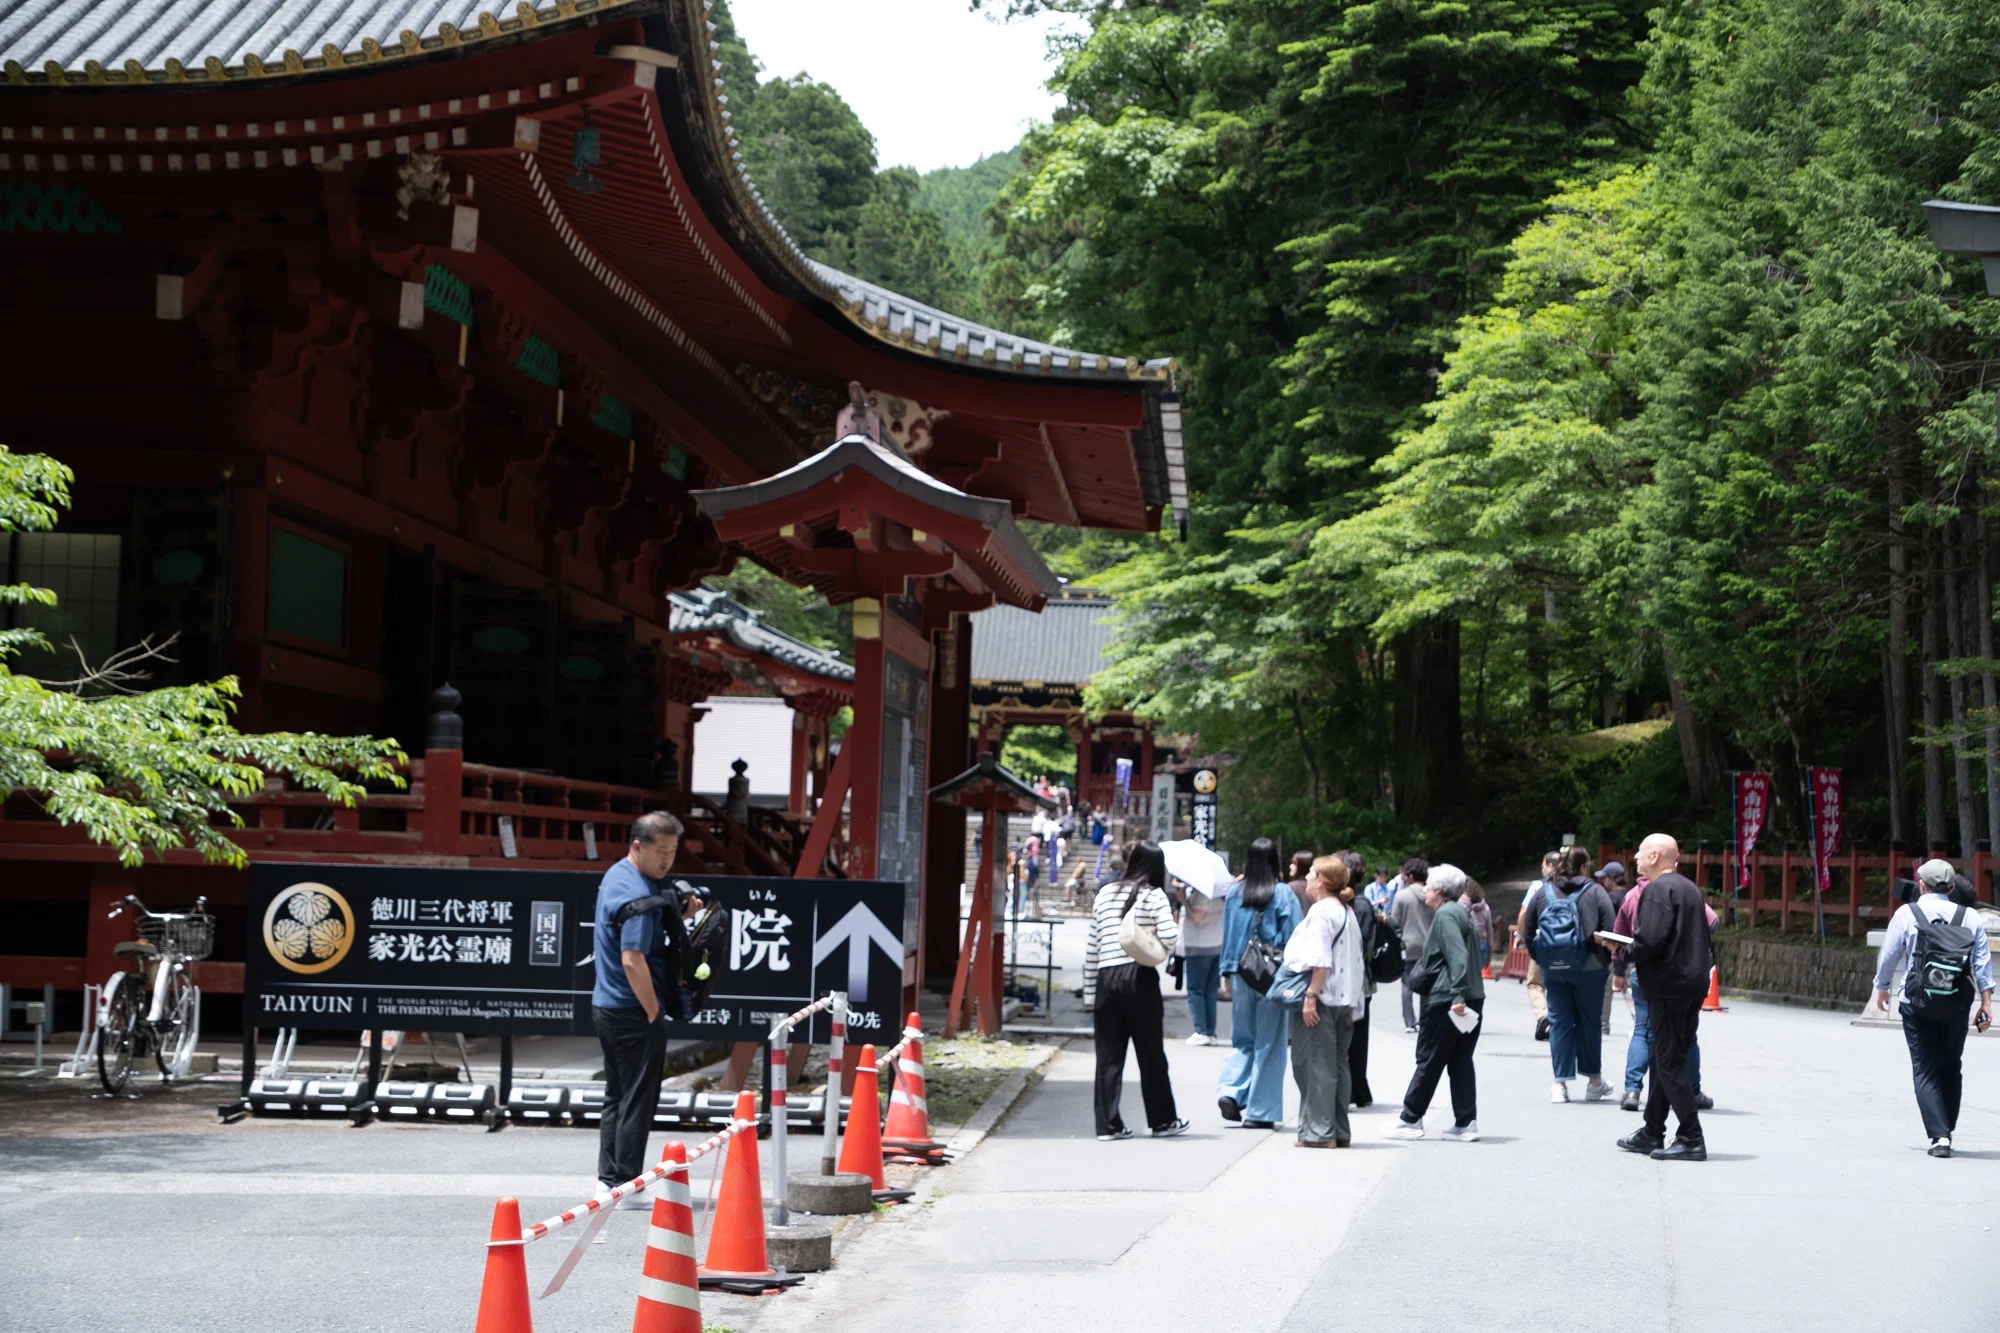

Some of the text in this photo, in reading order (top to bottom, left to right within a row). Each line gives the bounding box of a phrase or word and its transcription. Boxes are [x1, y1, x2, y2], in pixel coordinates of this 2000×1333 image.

[371, 897, 513, 924] 徳川三代将軍
[535, 913, 557, 955] 国宝
[368, 932, 512, 965] 家光公霊廟
[260, 994, 353, 1013] TAIYUIN
[377, 1004, 398, 1015] THE
[513, 1008, 574, 1020] MAUSOLEUM
[396, 997, 426, 1005] WORLD
[428, 998, 469, 1006] HERITAGE
[486, 1000, 529, 1008] NATIONAL
